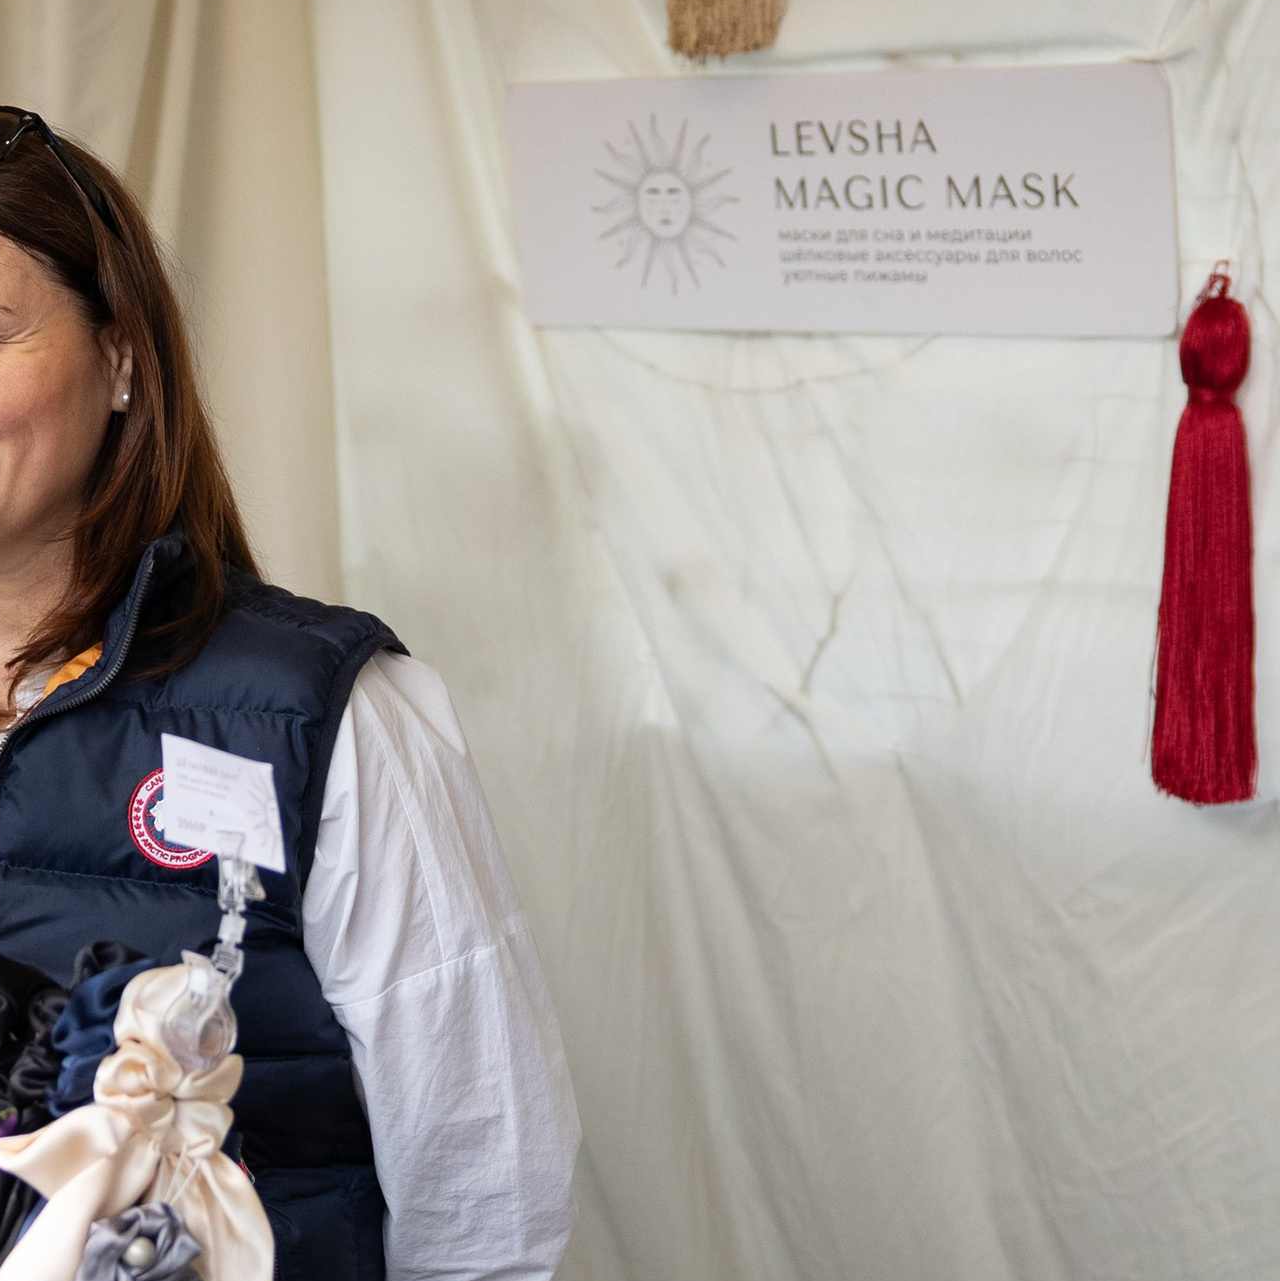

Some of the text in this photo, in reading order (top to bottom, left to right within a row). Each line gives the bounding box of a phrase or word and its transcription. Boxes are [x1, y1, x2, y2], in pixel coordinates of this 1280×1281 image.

[770, 119, 938, 157] LEVSHA
[773, 171, 1081, 211] MAGIC MASK
[778, 228, 1032, 244] маски для сна и медитации
[874, 248, 980, 266] аксессуары
[985, 248, 1020, 264] для
[1025, 248, 1084, 263] волос
[782, 269, 928, 284] уютные пижамы
[141, 839, 169, 860] ARCTIC
